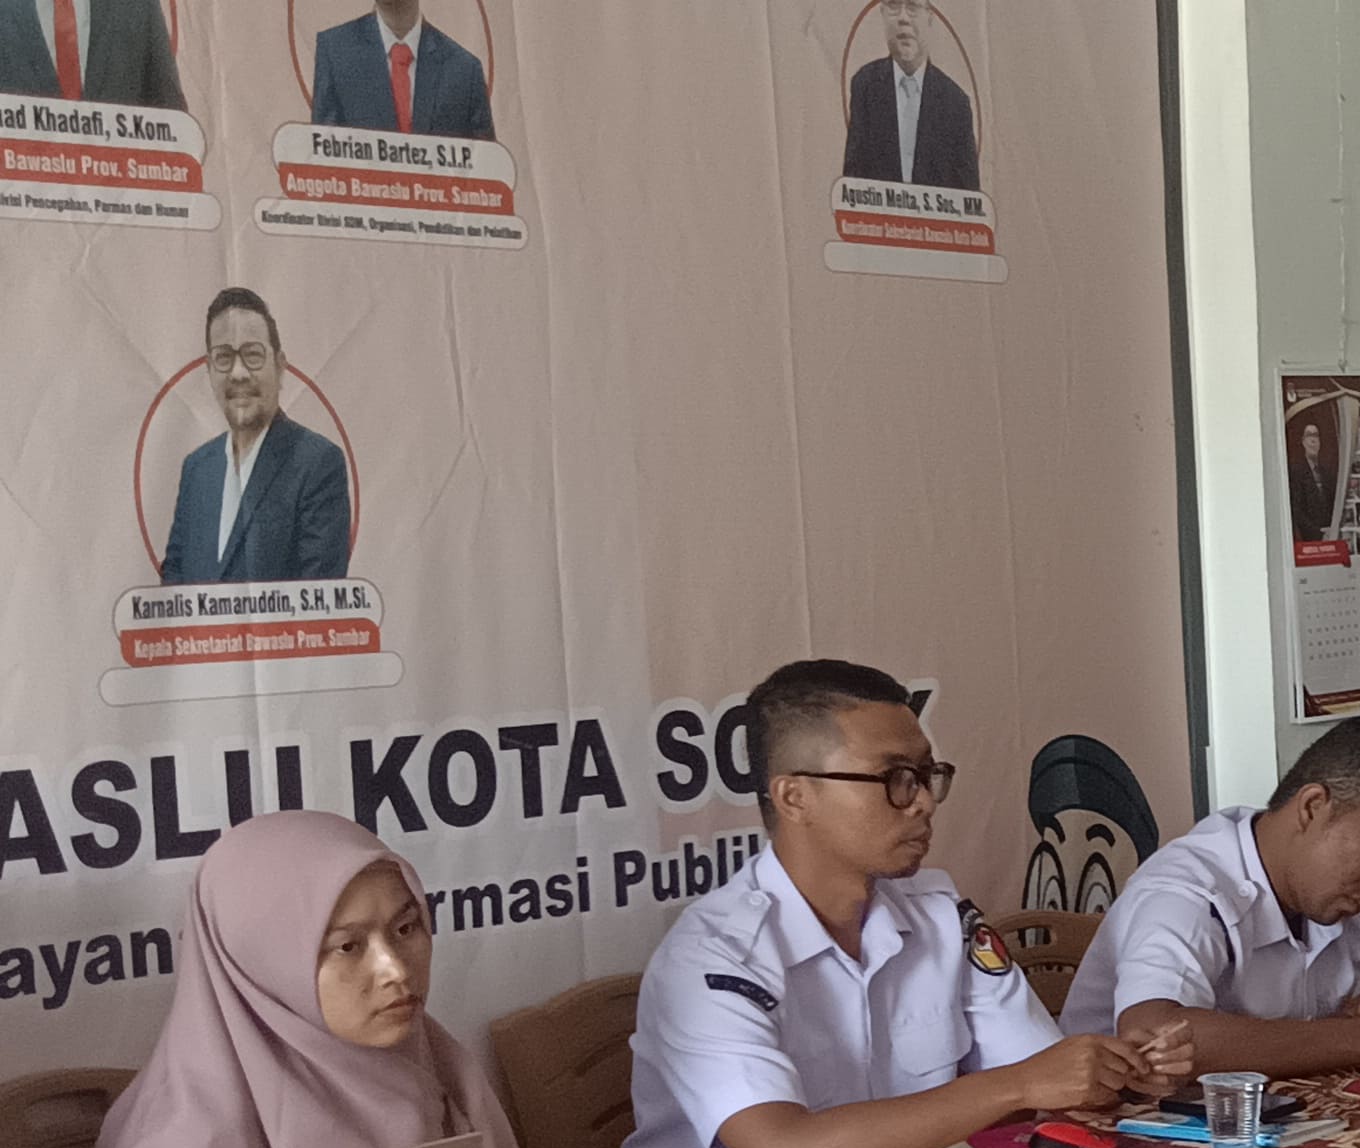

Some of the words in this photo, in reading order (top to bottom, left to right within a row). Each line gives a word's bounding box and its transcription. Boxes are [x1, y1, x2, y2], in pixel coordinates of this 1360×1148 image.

[0, 104, 26, 130] ad
[33, 105, 111, 142] Khadafi,
[115, 113, 178, 142] S.Kom.
[4, 149, 76, 174] Bawaslu
[81, 155, 123, 178] Prov.
[127, 158, 189, 183] Sumbar
[312, 132, 373, 161] Febrian
[377, 139, 433, 170] Bartez,
[436, 144, 473, 169] S.I.P.
[286, 172, 347, 198] Anggota
[351, 179, 410, 201] Bawaslu
[414, 182, 448, 203] Prov.
[451, 185, 503, 207] Sumbar
[841, 183, 883, 208] Agustin
[131, 594, 193, 620] Karnalis
[197, 589, 296, 617] Kamaruddin,
[299, 588, 330, 615] S.H,
[334, 586, 372, 610] M.Si.
[134, 638, 172, 661] Kepala
[175, 633, 244, 657] Sekretariat
[246, 631, 295, 651] Bawaslu
[328, 628, 371, 647] Sumbar
[350, 718, 627, 835] KOTA
[0, 926, 183, 1010] ayan
[430, 857, 590, 935] rmasi
[613, 833, 759, 907] Publi
